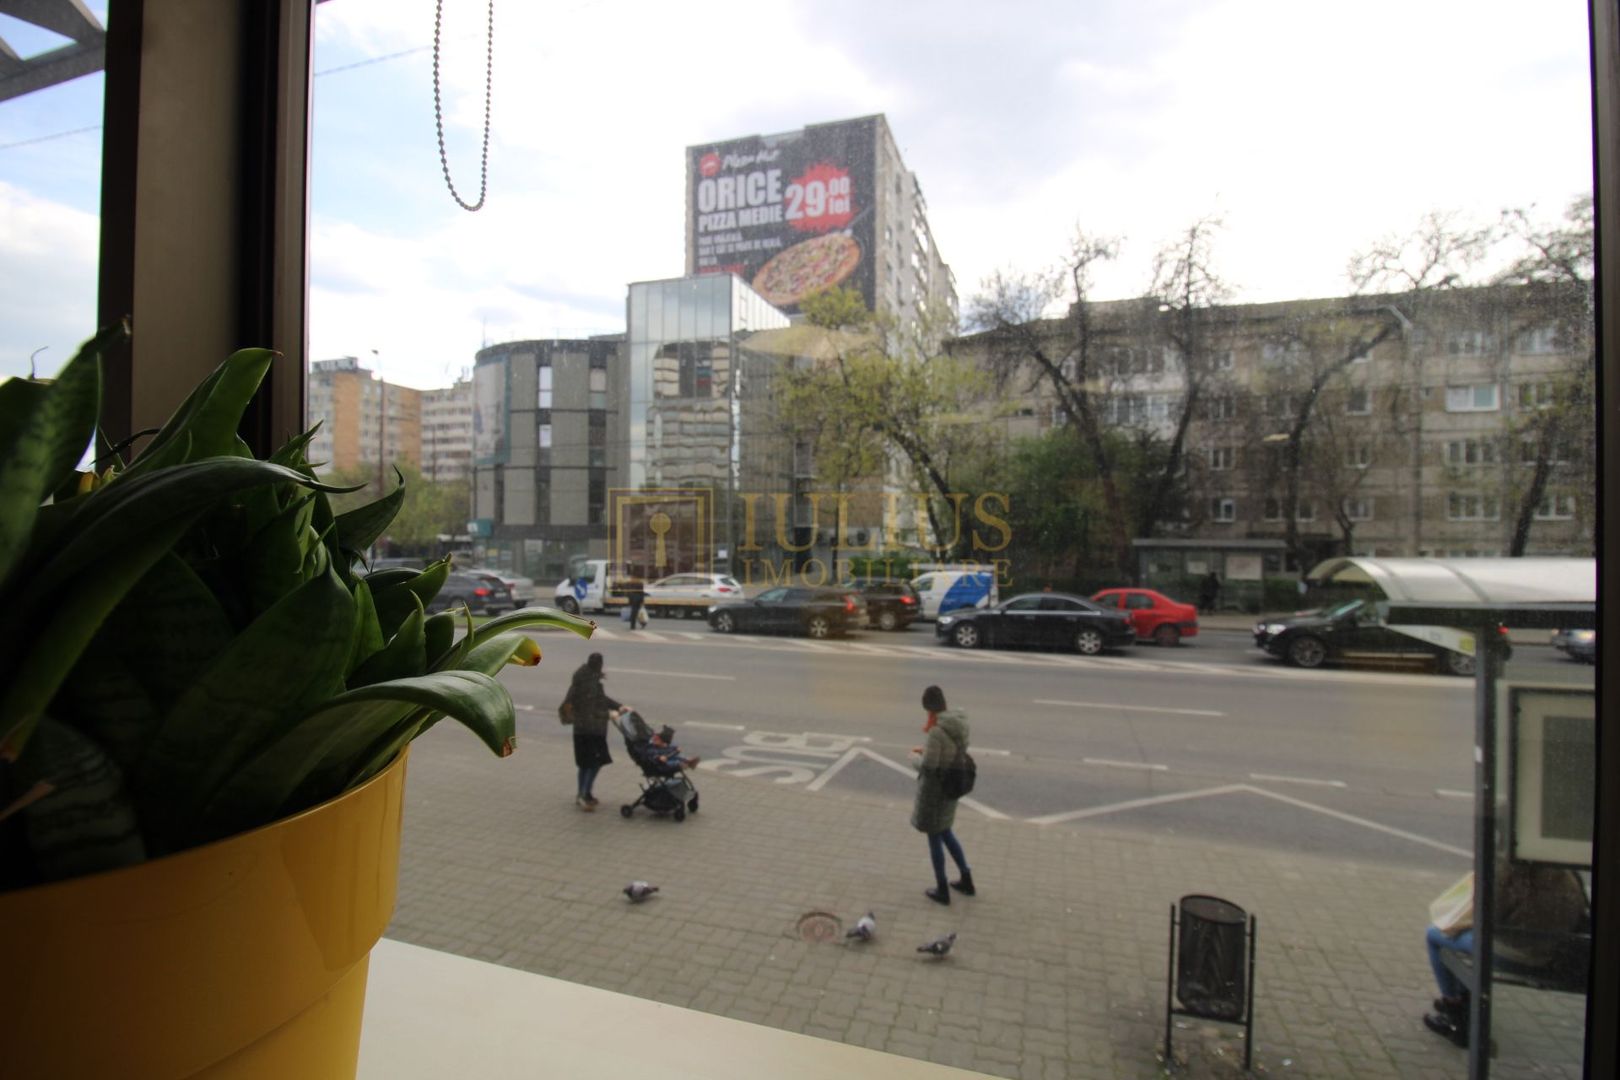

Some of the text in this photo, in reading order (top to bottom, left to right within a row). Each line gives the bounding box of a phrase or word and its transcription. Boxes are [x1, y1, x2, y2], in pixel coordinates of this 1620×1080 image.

[698, 169, 782, 213] ORICE
[785, 181, 826, 220] 29
[699, 204, 783, 232] PIZZA MEDIE
